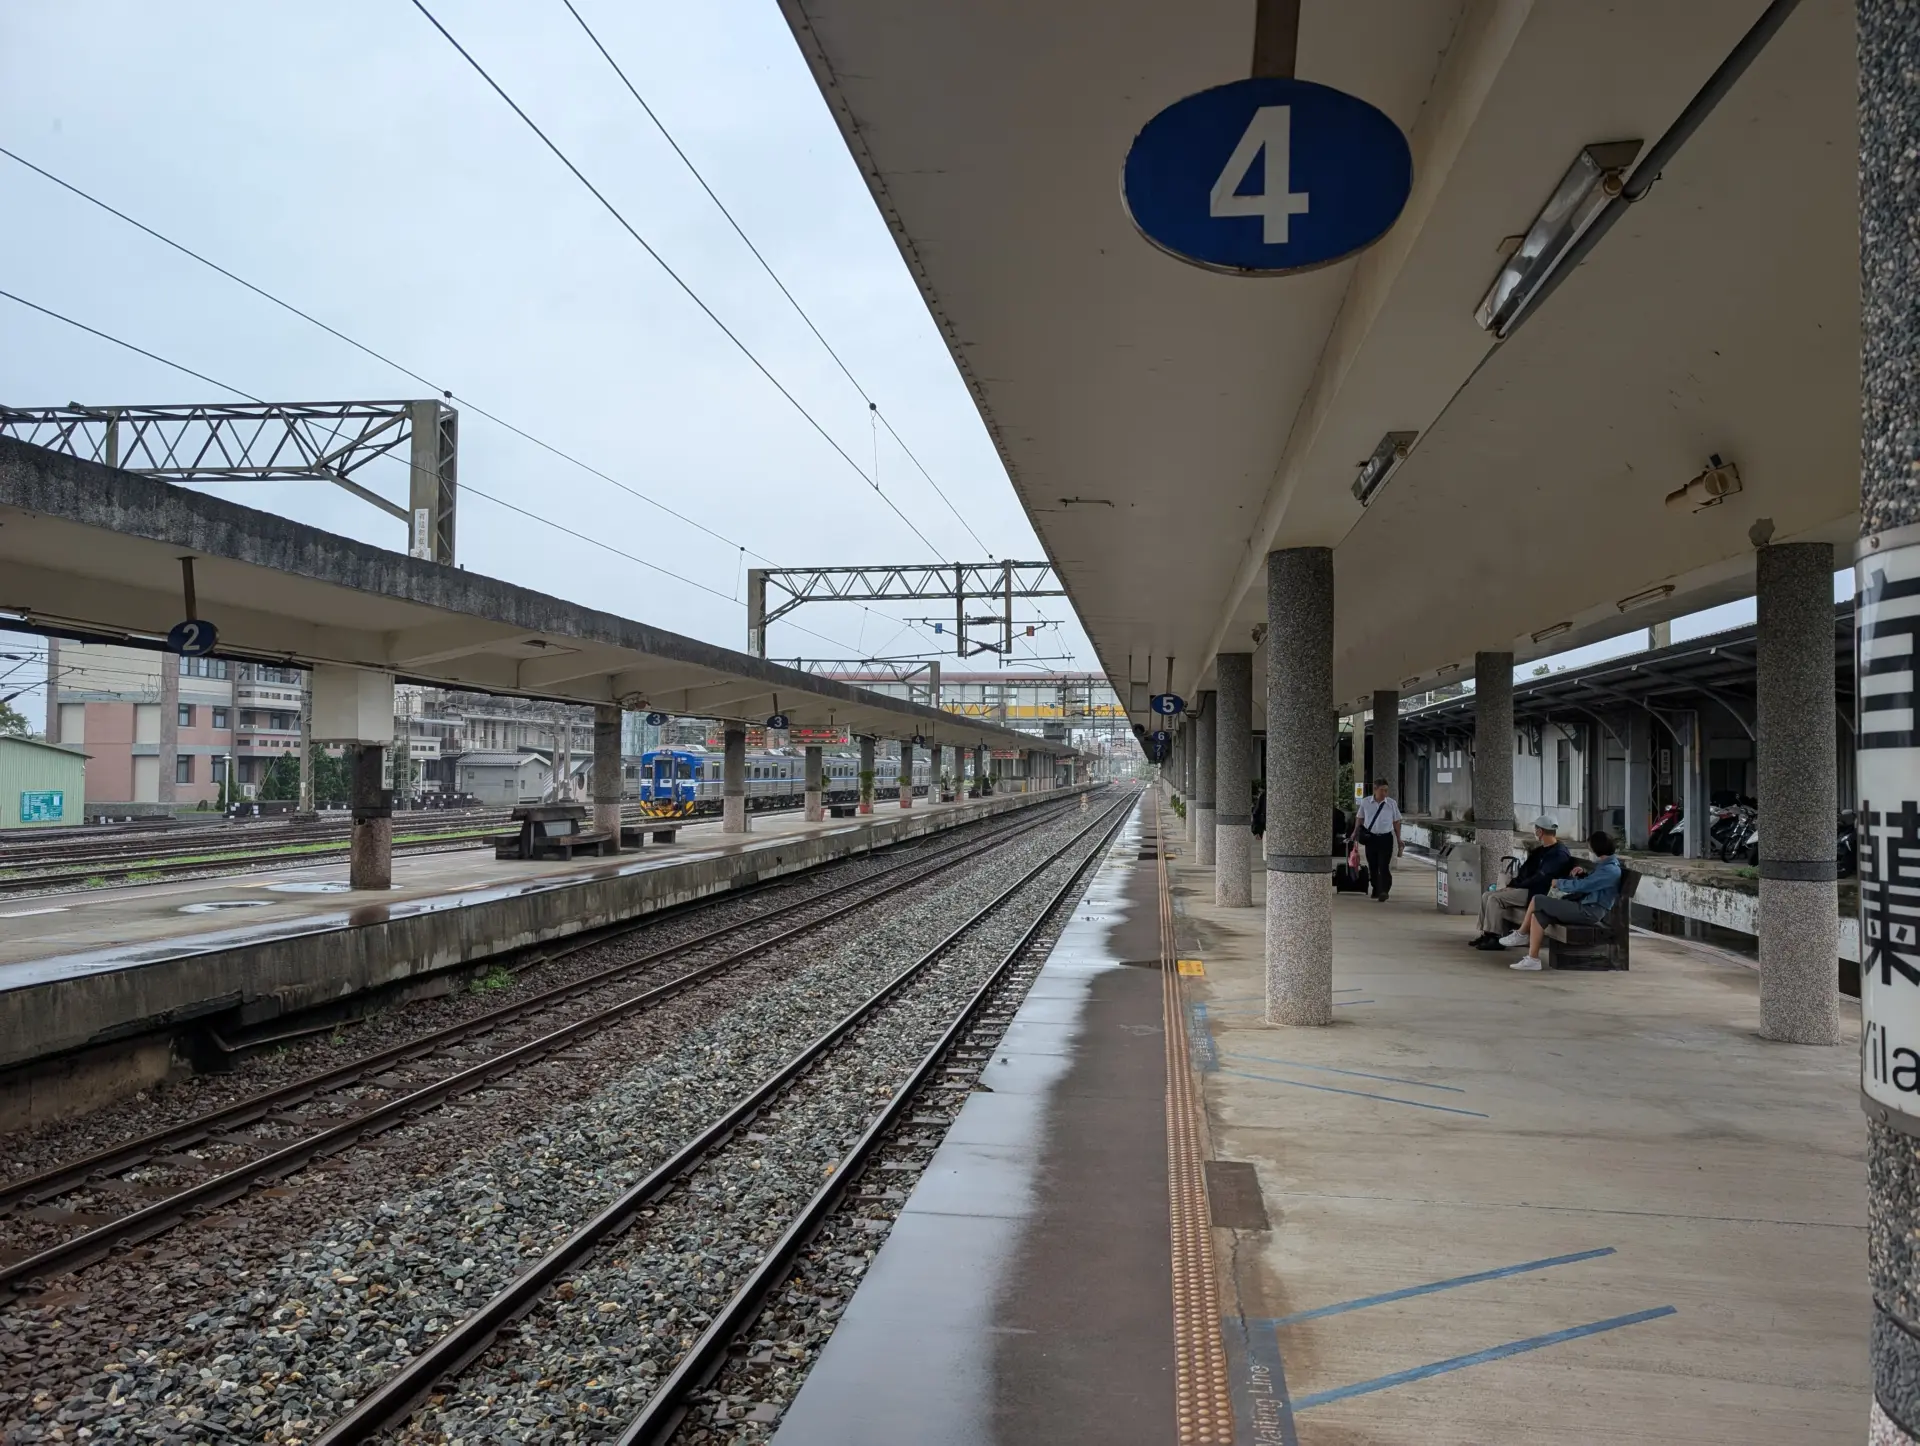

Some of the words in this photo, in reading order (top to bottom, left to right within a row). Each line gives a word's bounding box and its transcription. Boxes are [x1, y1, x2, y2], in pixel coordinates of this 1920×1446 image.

[1210, 105, 1309, 244] 4
[182, 623, 200, 651] 2
[1162, 696, 1174, 712] 5
[652, 713, 661, 725] 3
[774, 716, 783, 727] 3
[1158, 732, 1164, 740] 6
[1246, 1365, 1273, 1393] Line
